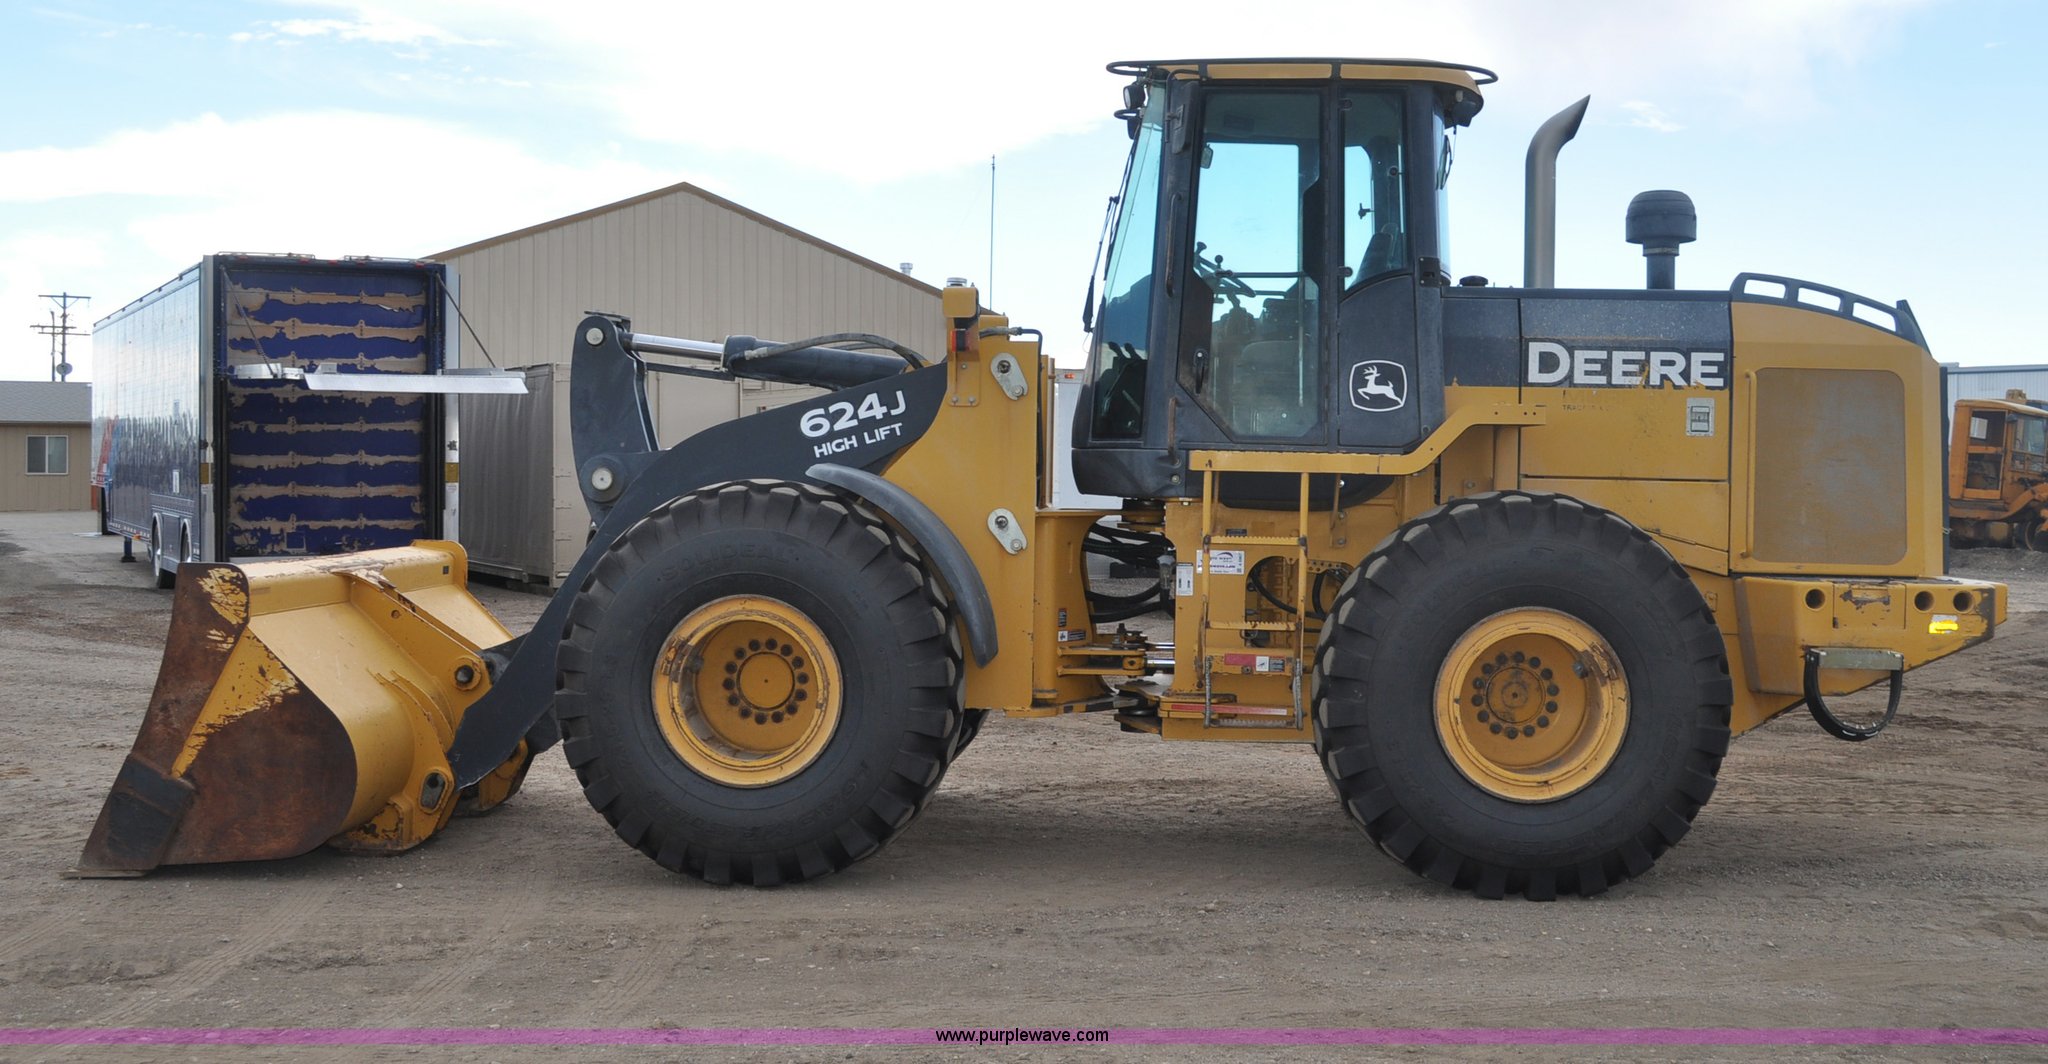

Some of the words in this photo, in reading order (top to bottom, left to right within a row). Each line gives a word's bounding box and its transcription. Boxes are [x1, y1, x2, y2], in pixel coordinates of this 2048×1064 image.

[1528, 341, 1725, 387] DEERE
[800, 390, 907, 438] 624J
[813, 434, 858, 458] HIGH
[863, 422, 903, 445] LIFT
